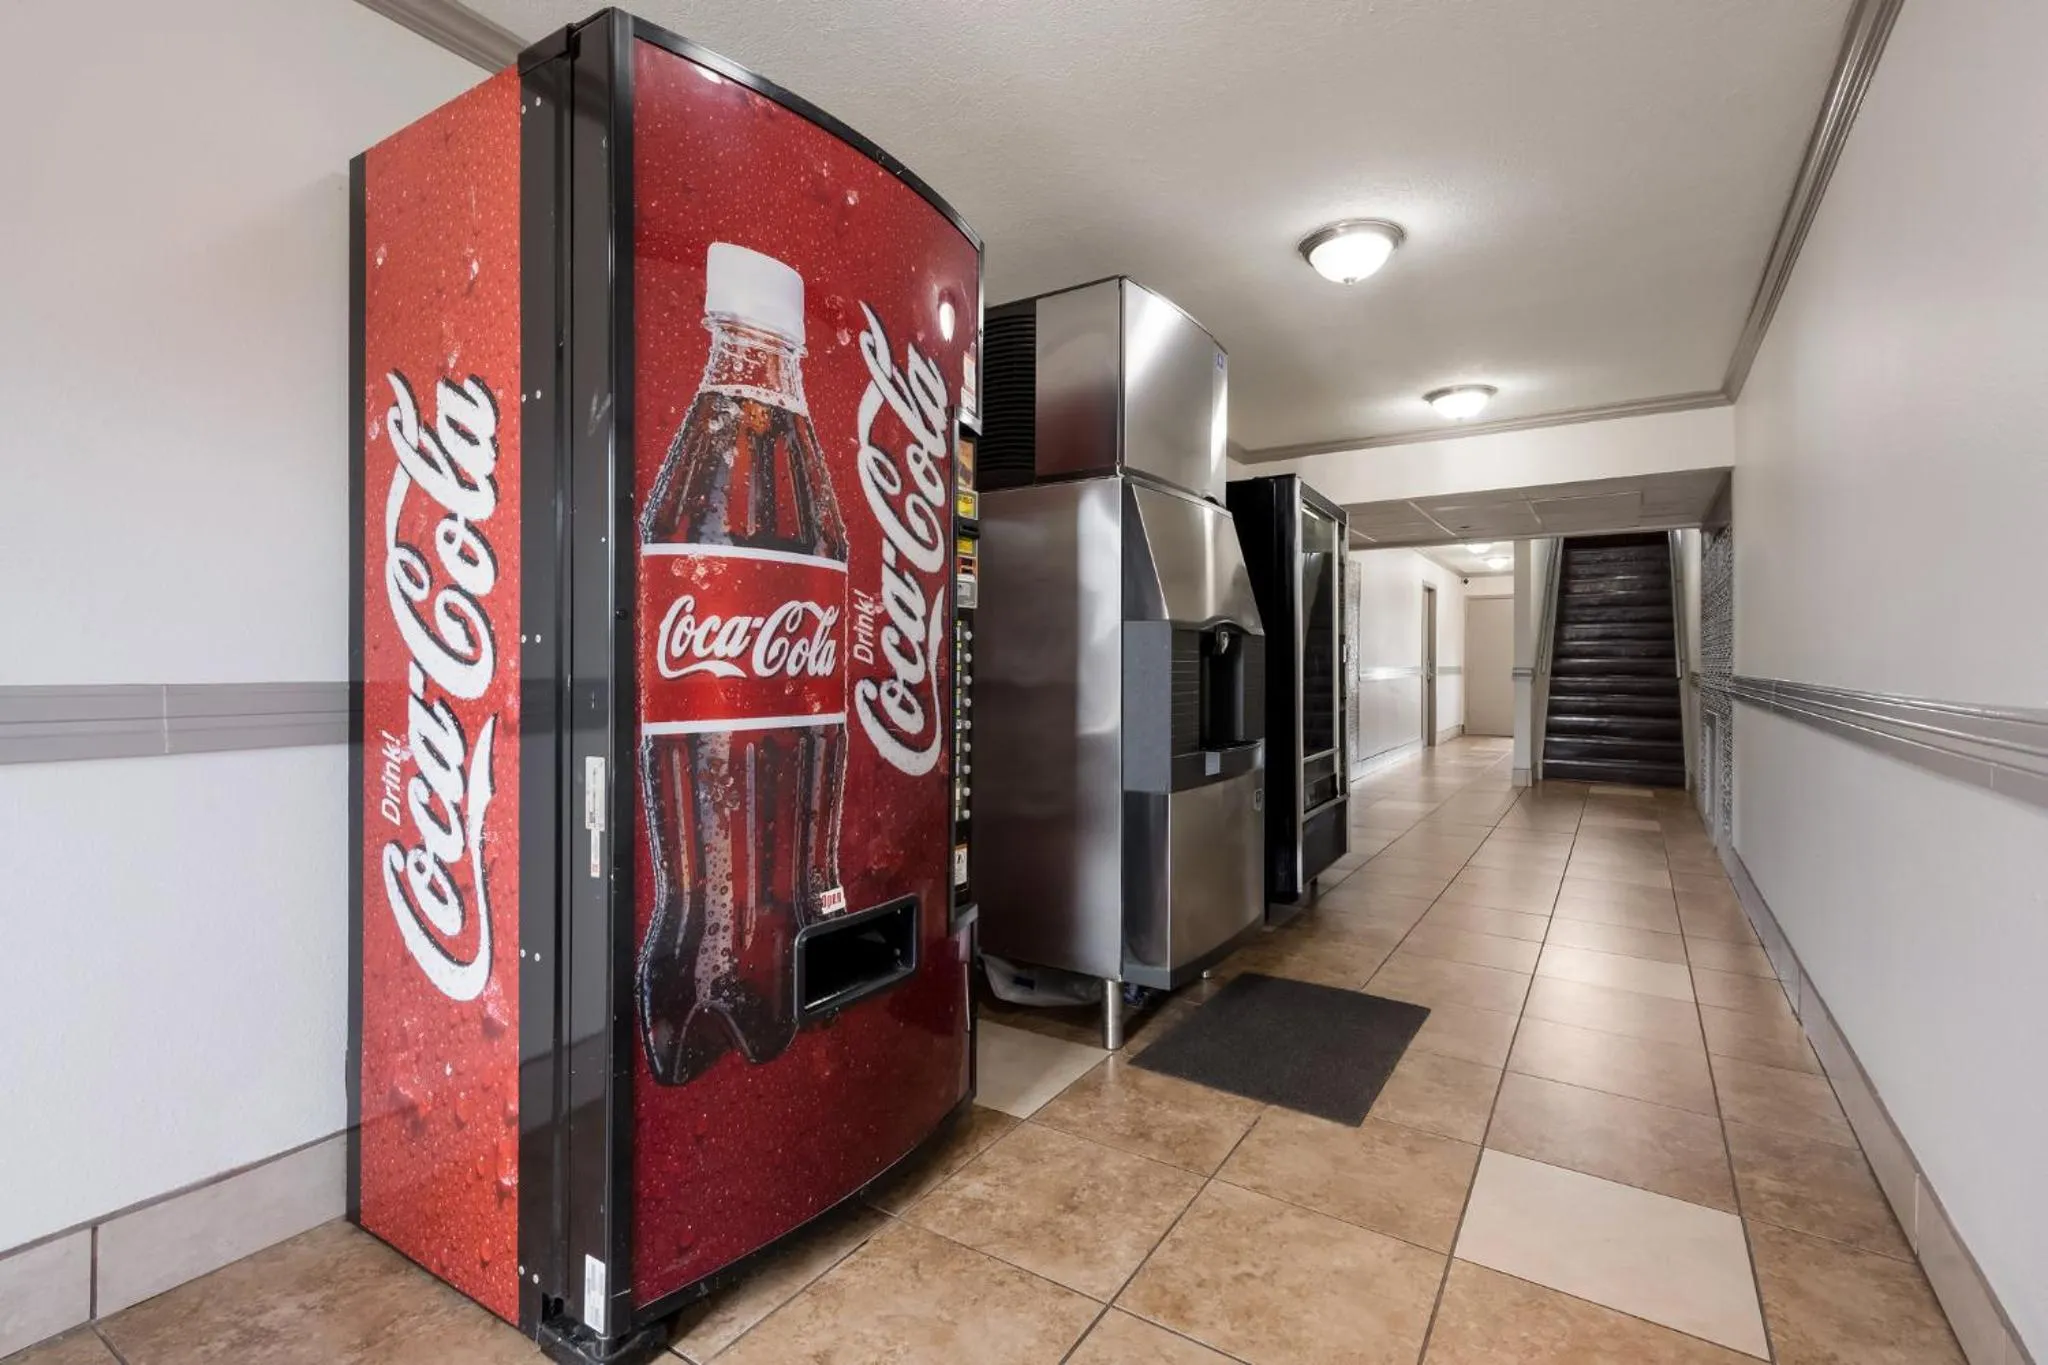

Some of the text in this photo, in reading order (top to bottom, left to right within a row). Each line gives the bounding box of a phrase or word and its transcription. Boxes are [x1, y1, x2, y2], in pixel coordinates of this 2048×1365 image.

[855, 300, 947, 776] Coca-Cola
[656, 593, 840, 679] Coca-Cola
[852, 589, 875, 666] Drink!
[384, 368, 498, 1001] Coca-Cola
[381, 729, 401, 826] Drink!
